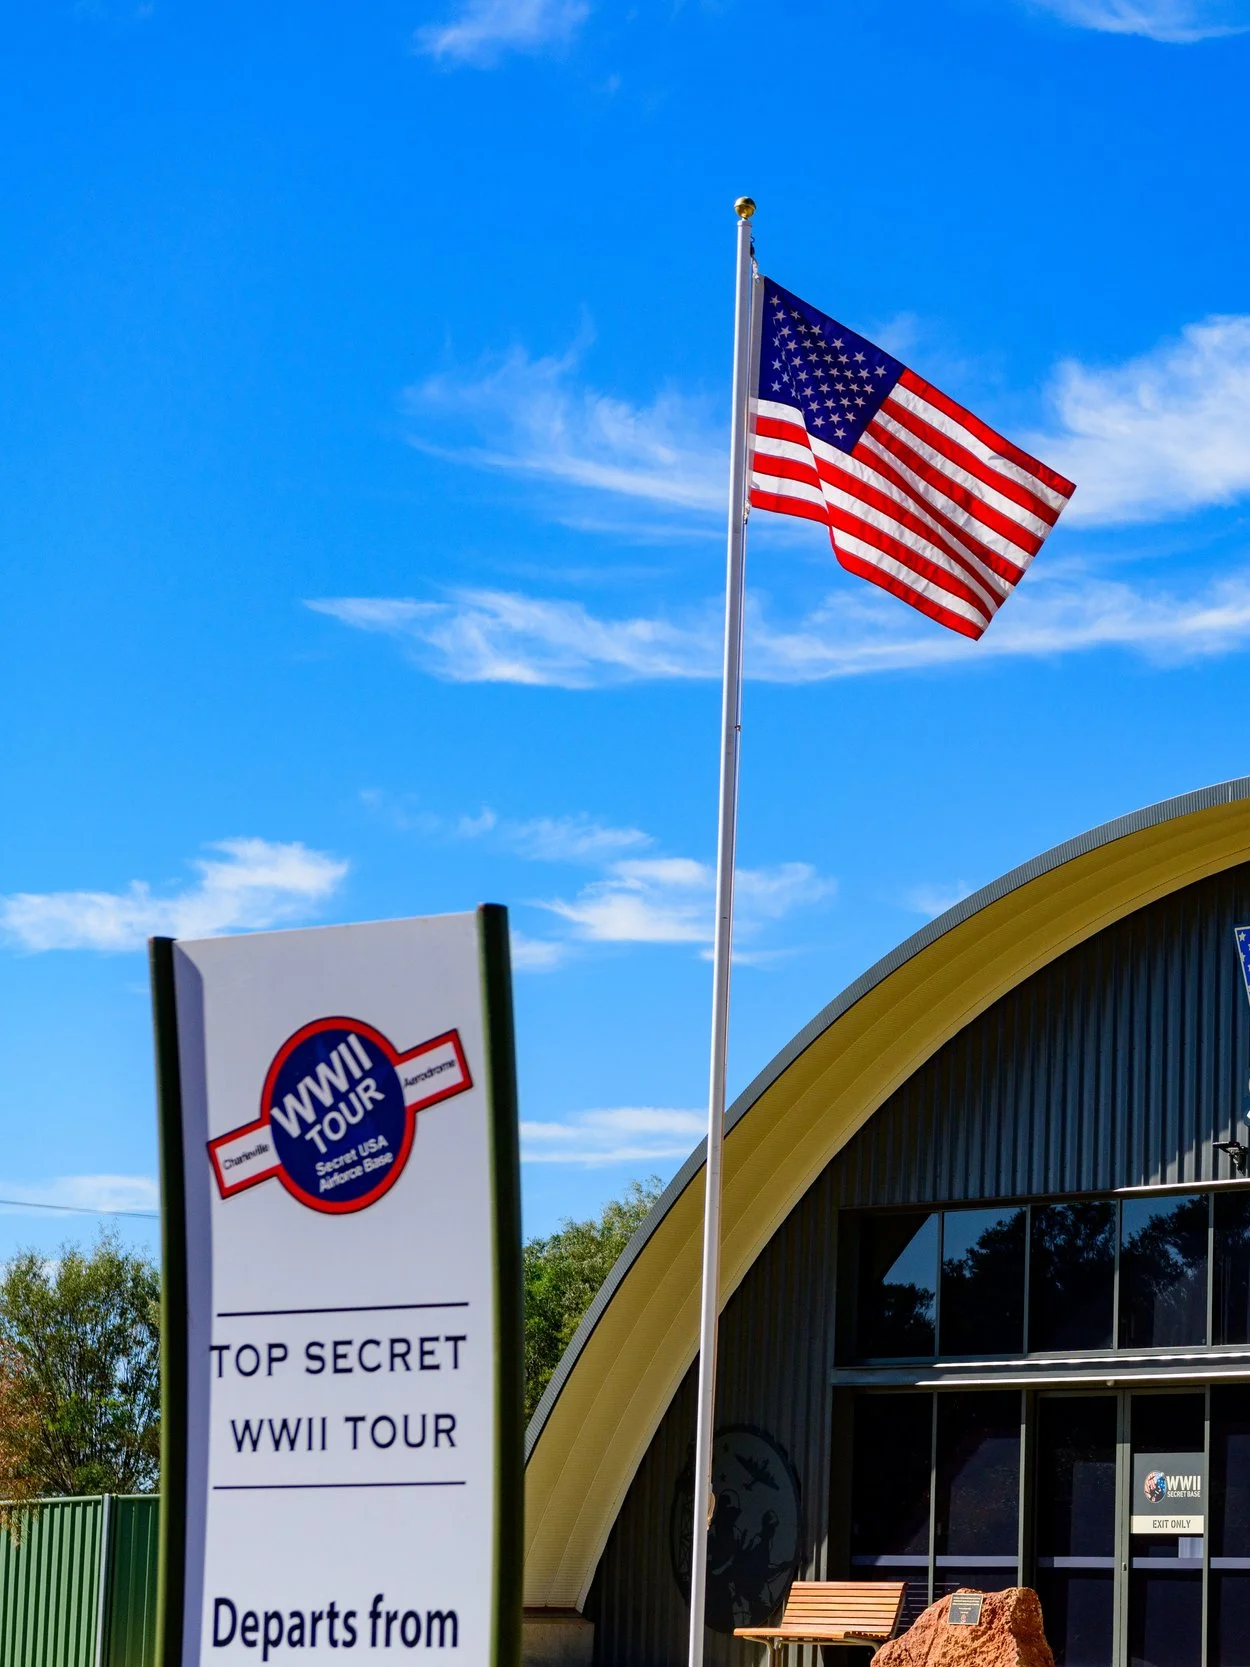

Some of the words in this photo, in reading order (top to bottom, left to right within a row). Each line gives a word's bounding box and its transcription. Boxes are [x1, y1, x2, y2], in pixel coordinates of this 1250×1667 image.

[270, 1032, 374, 1139] WWII
[404, 1059, 456, 1088] Aerodrome
[304, 1077, 386, 1154] TOUR
[315, 1148, 358, 1176] Secret
[358, 1134, 389, 1157] USA
[319, 1165, 364, 1193] Airforce
[362, 1152, 393, 1173] Base
[209, 1343, 289, 1378] TOP
[305, 1335, 467, 1375] SECRET
[230, 1416, 327, 1452] WWII
[344, 1413, 457, 1450] TOUR
[1166, 1475, 1201, 1491] WWII
[1167, 1490, 1187, 1498] SECRET
[1187, 1490, 1201, 1498] BASE
[1152, 1519, 1169, 1529] EXIT
[1170, 1519, 1191, 1529] ONLY
[212, 1597, 357, 1662] Departs
[369, 1593, 459, 1648] from
